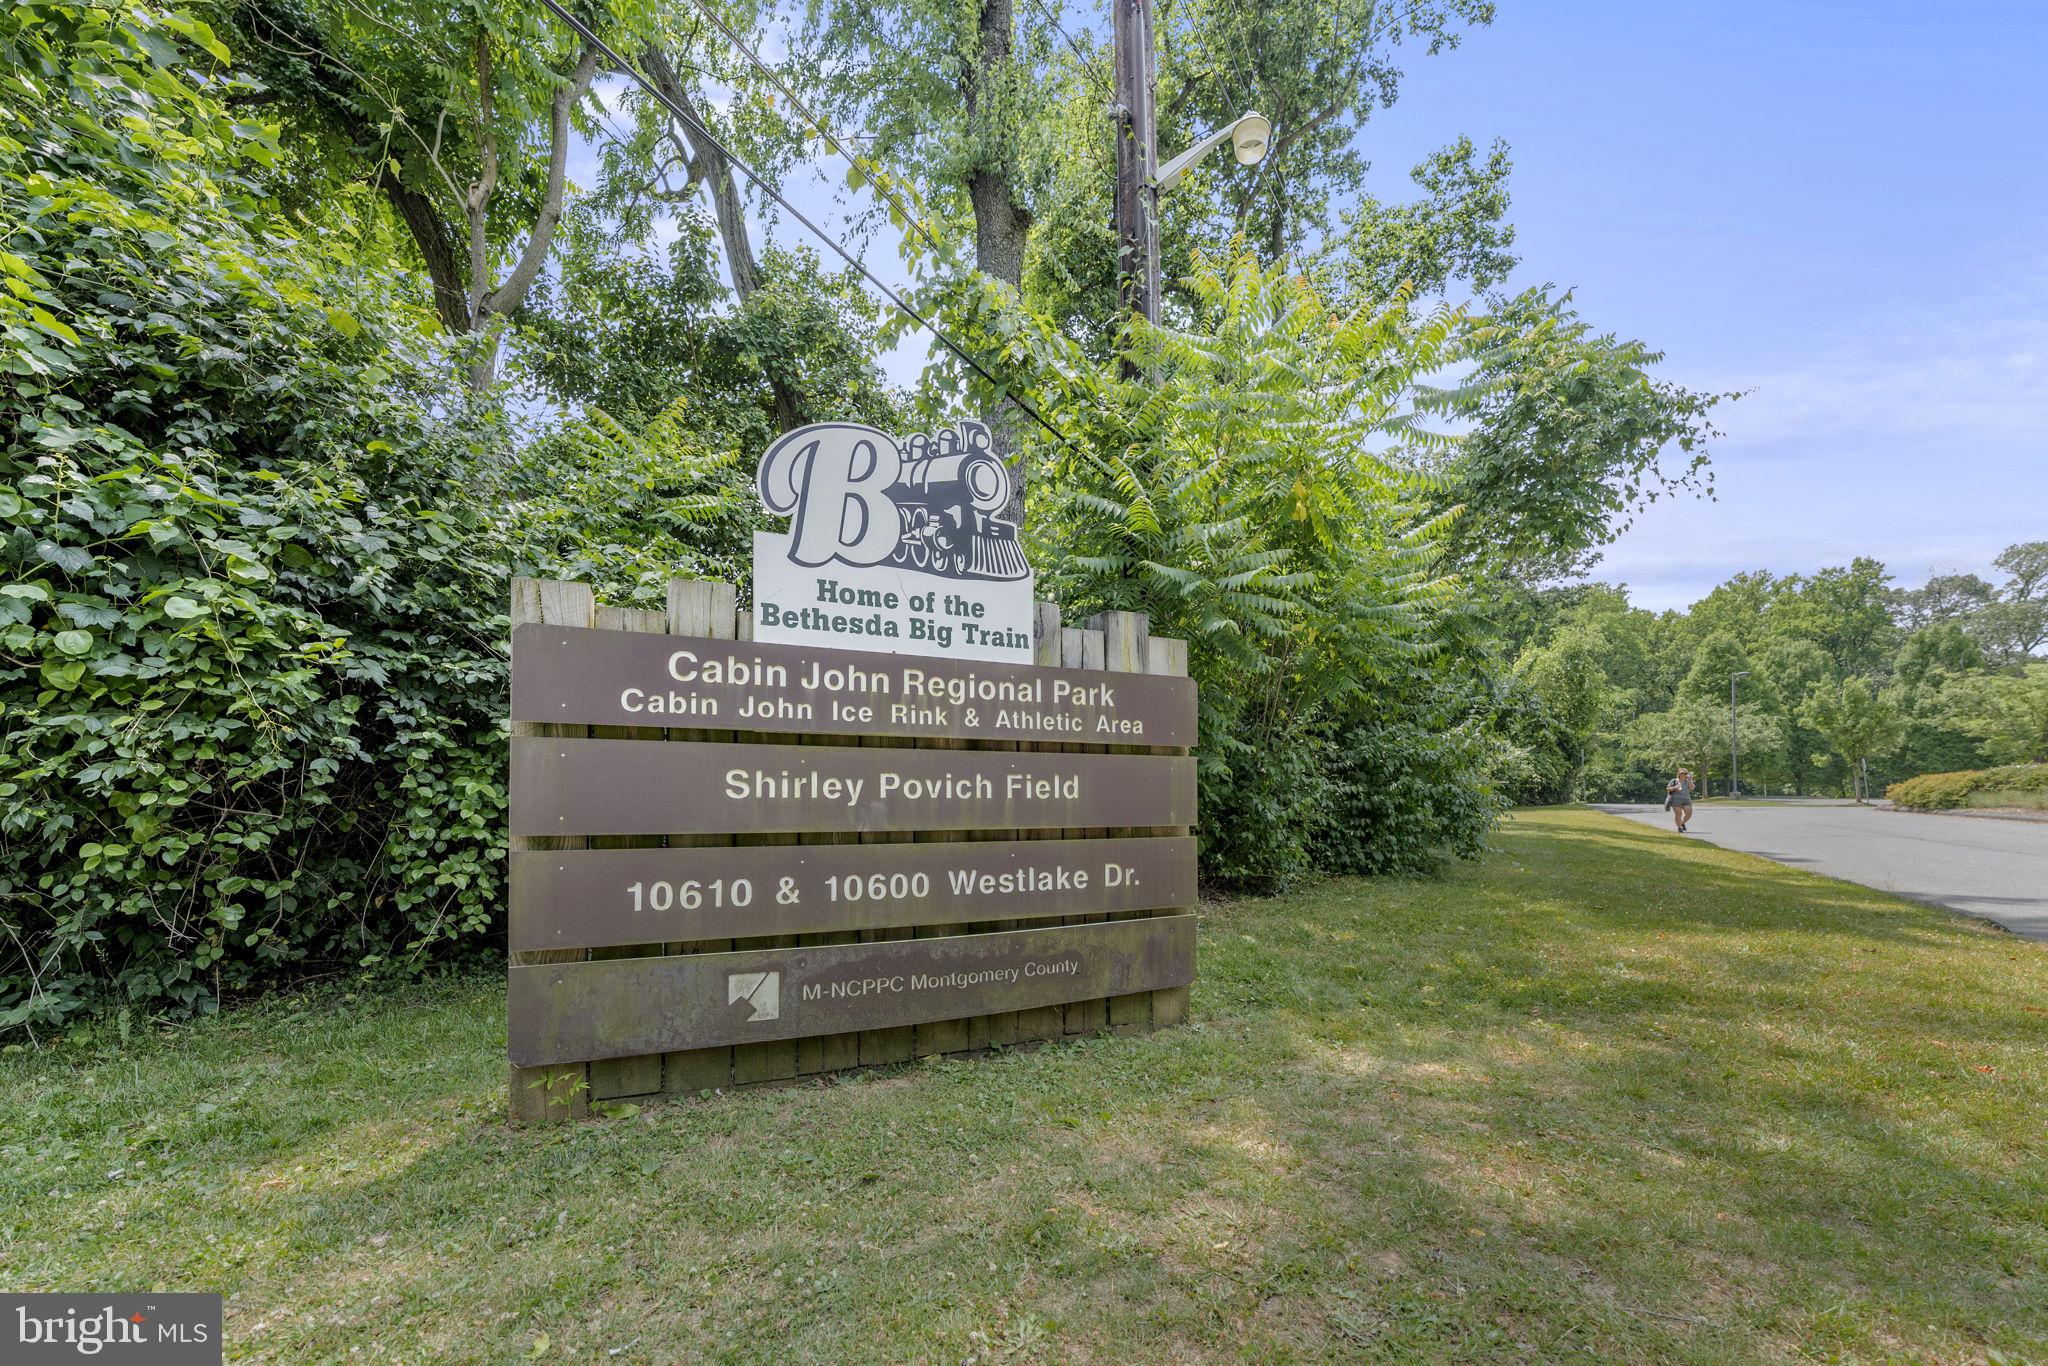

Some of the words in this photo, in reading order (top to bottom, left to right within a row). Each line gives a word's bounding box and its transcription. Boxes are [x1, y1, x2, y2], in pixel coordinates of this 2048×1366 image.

[816, 578, 899, 609] Home
[909, 591, 935, 612] of
[943, 594, 985, 618] the
[760, 602, 899, 638] Bethesda
[909, 617, 952, 648] Big
[961, 623, 1030, 649] Train
[668, 650, 787, 688] Cabin
[800, 661, 890, 695] John
[903, 668, 1042, 705] Regional
[1053, 679, 1115, 707] Park
[620, 688, 719, 716] Cabin
[738, 695, 813, 720] John
[832, 700, 874, 722] Ice
[891, 703, 948, 726] Rink
[964, 707, 980, 728] &
[995, 709, 1083, 732] Athletic
[1096, 714, 1144, 735] Area
[725, 768, 864, 806] Shirley
[880, 772, 993, 801] Povich
[1007, 774, 1081, 801] Field
[626, 878, 753, 912] 10610
[775, 876, 801, 905] &
[824, 871, 930, 902] 10600
[948, 867, 1090, 896] Westlake
[1105, 863, 1141, 888] Dr.
[802, 975, 905, 1001] M-NCPPC
[911, 967, 1019, 991] Montgomery
[1024, 959, 1079, 977] County
